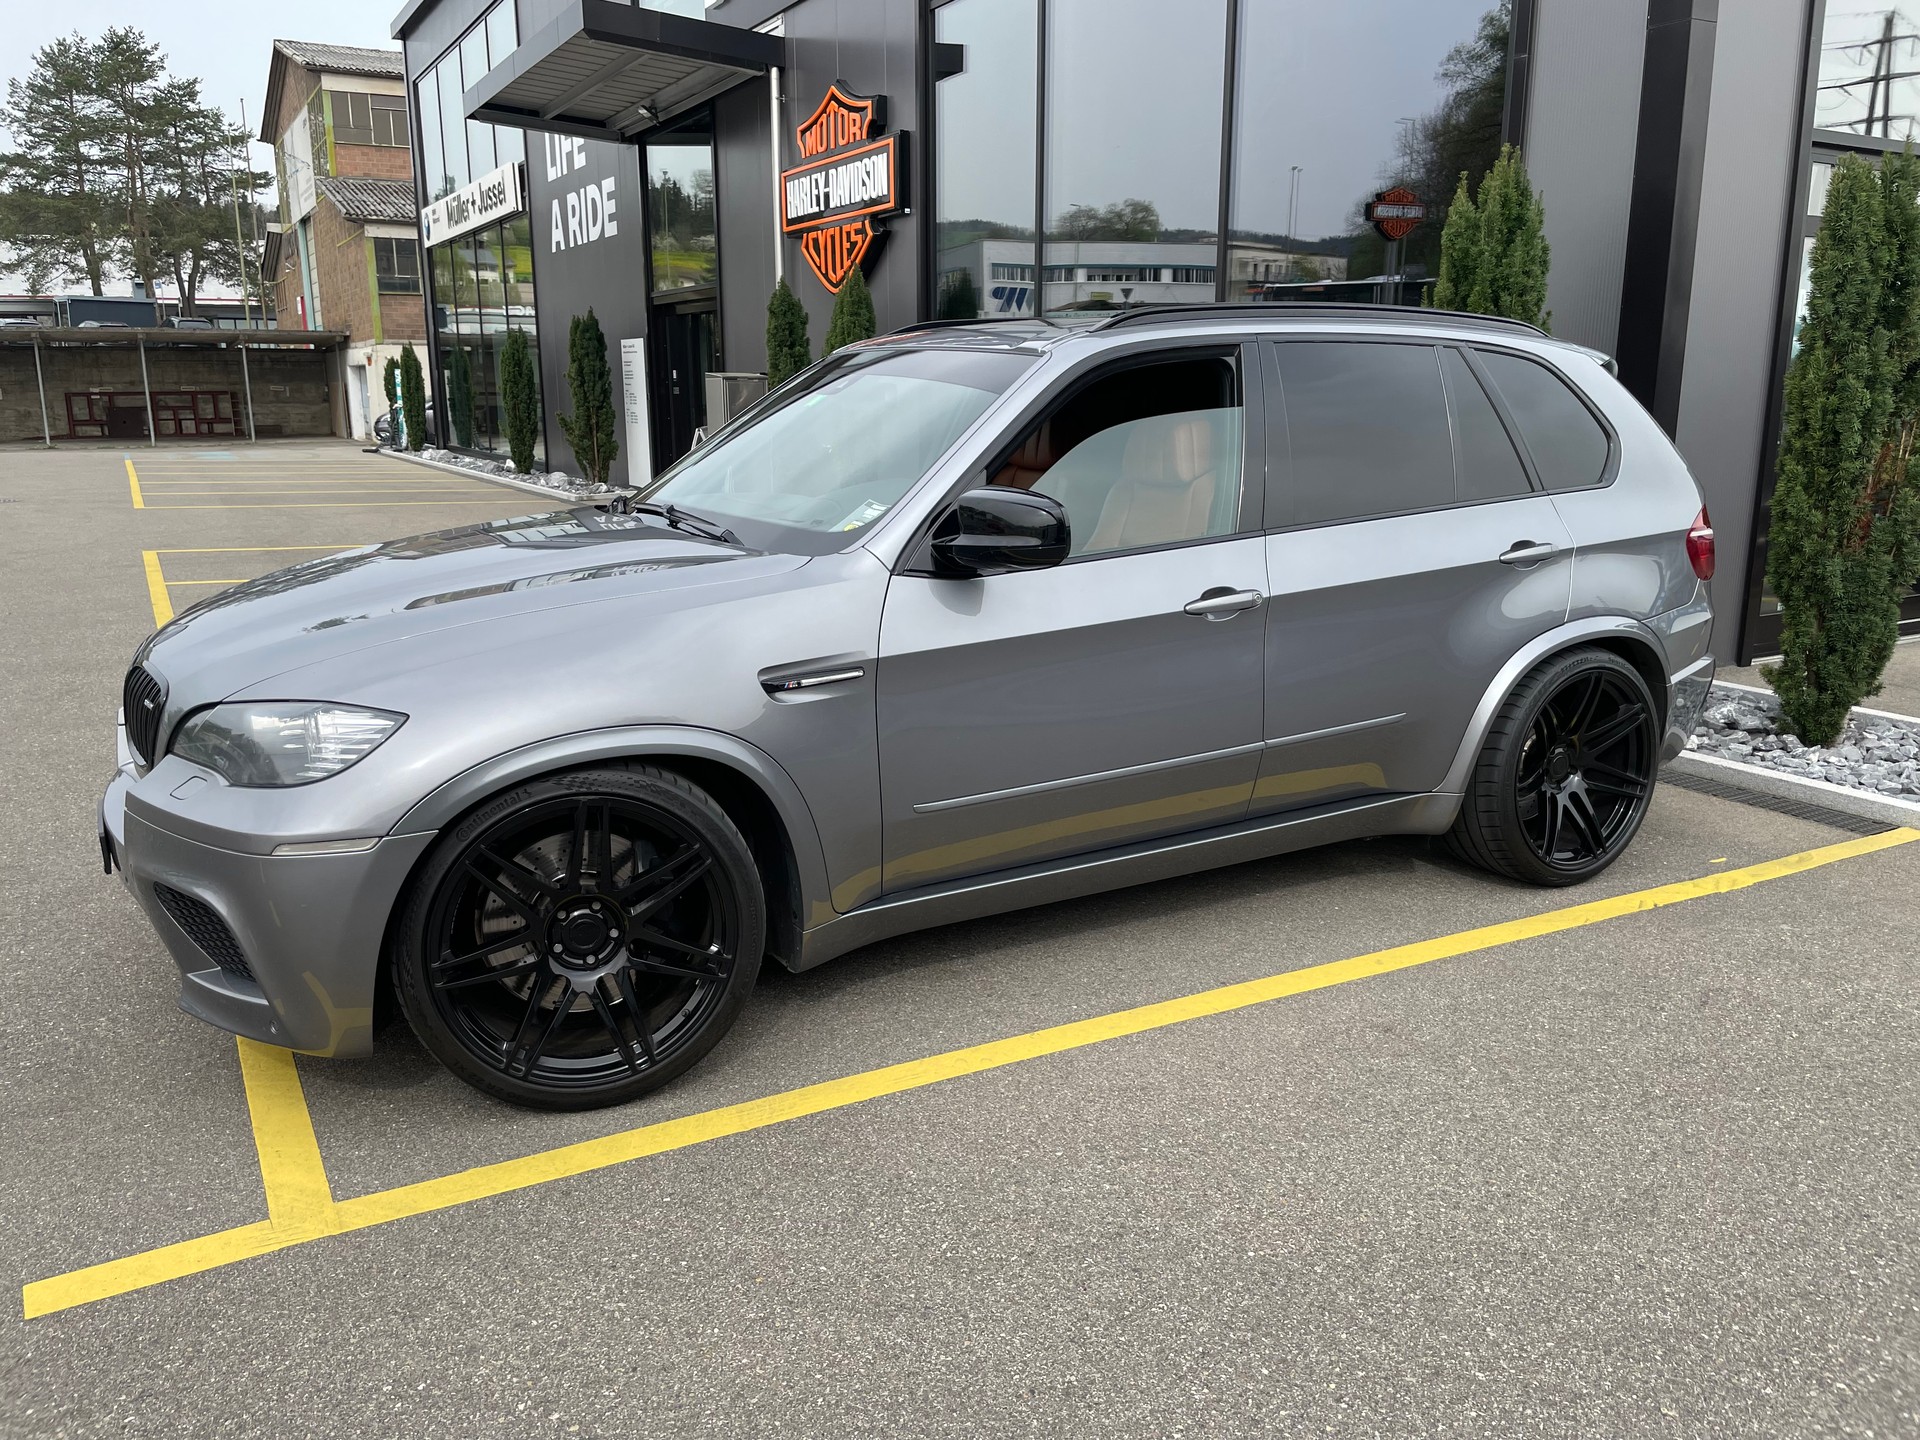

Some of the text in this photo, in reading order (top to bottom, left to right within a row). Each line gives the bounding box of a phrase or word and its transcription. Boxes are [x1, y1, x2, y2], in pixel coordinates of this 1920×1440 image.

[545, 132, 586, 182] LIFE
[805, 100, 863, 155] MOTOR
[446, 194, 470, 229] Müller
[478, 170, 506, 215] Jussel
[551, 176, 618, 253] A RIDE
[786, 152, 889, 220] HARLEY-DAVIDSON
[808, 220, 864, 284] CYCLES
[456, 791, 521, 842] Continental
